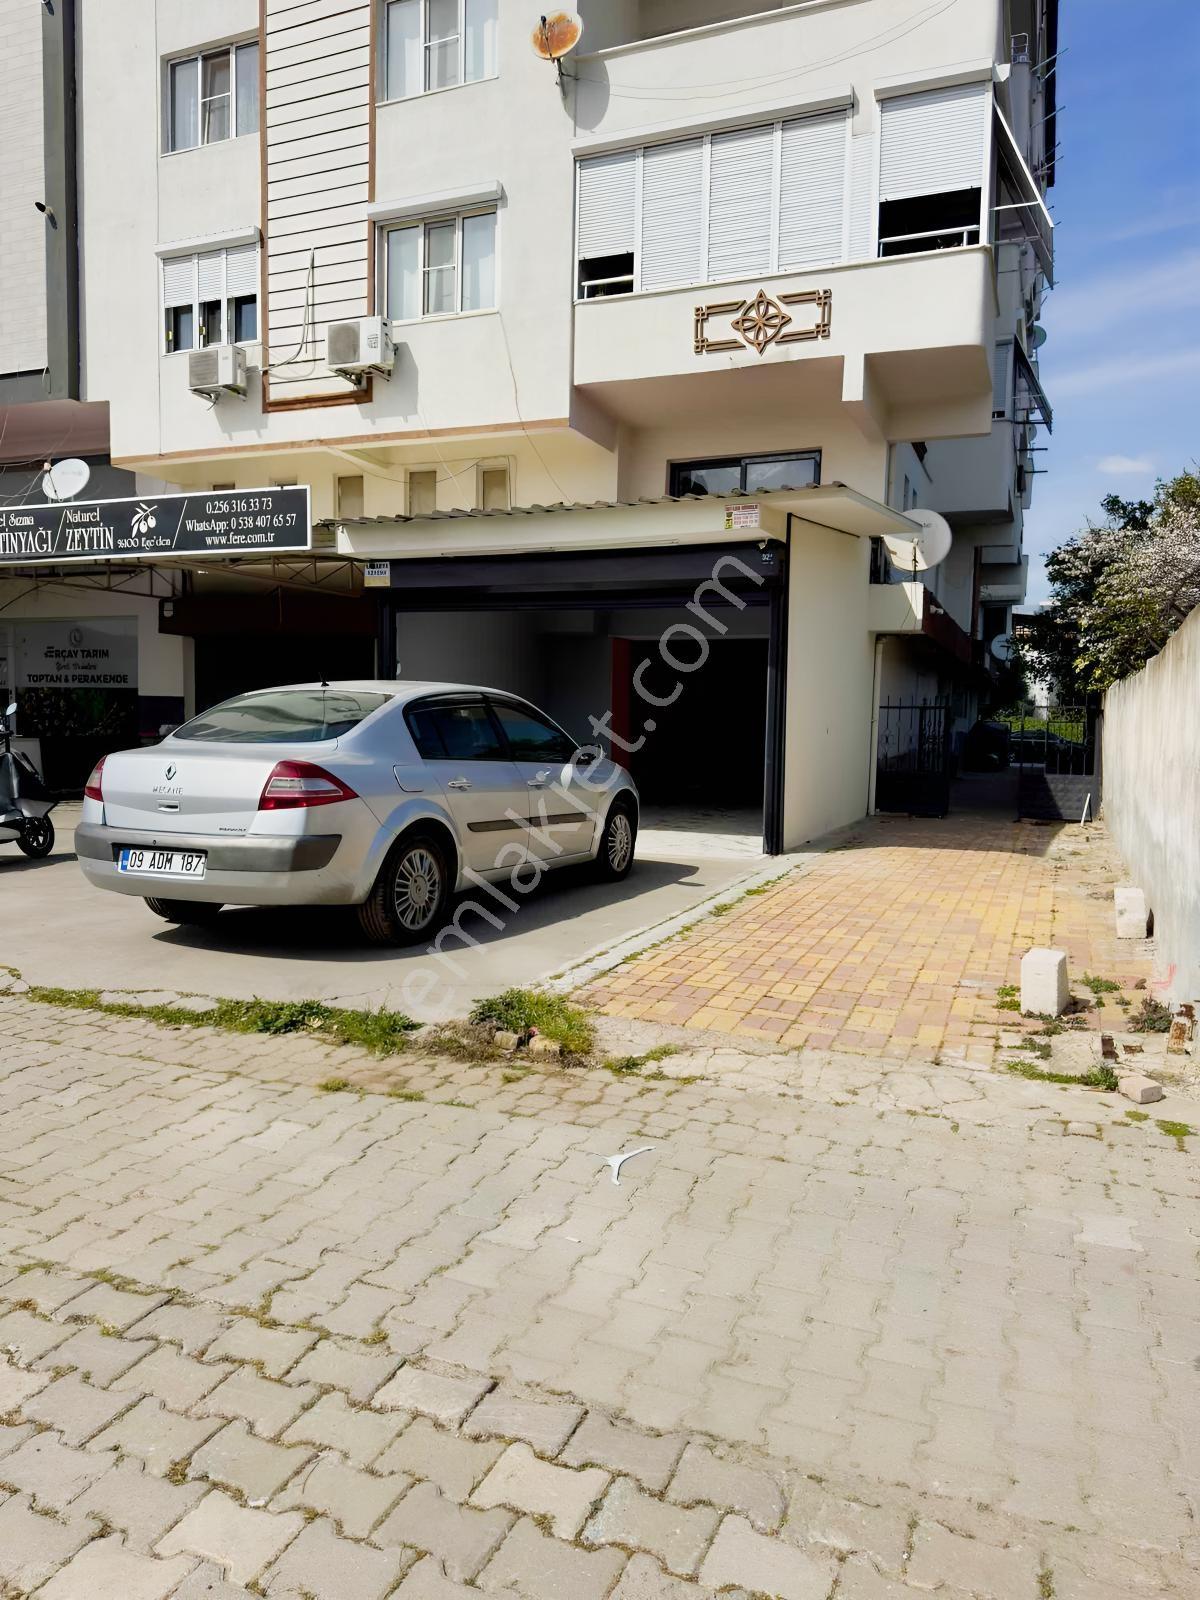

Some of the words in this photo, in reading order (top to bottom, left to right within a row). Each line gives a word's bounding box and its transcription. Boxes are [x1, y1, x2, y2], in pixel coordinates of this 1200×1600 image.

[206, 501, 229, 514] 0.256
[231, 500, 247, 512] 316
[249, 499, 260, 511] 33
[262, 498, 273, 510] 73
[66, 507, 100, 523] Naturel
[185, 519, 229, 533] WhatsApp:
[231, 517, 236, 529] 0
[239, 516, 253, 529] 538
[255, 515, 271, 527] 407
[273, 514, 284, 527] 65
[286, 513, 297, 526] 57
[66, 522, 114, 551] ZEYTİN
[80, 649, 109, 659] TARIM
[27, 674, 62, 683] TOPTAN
[72, 674, 128, 684] PERAKENDE
[129, 851, 144, 868] 09
[149, 853, 174, 871] ADM
[181, 855, 203, 873] 187
